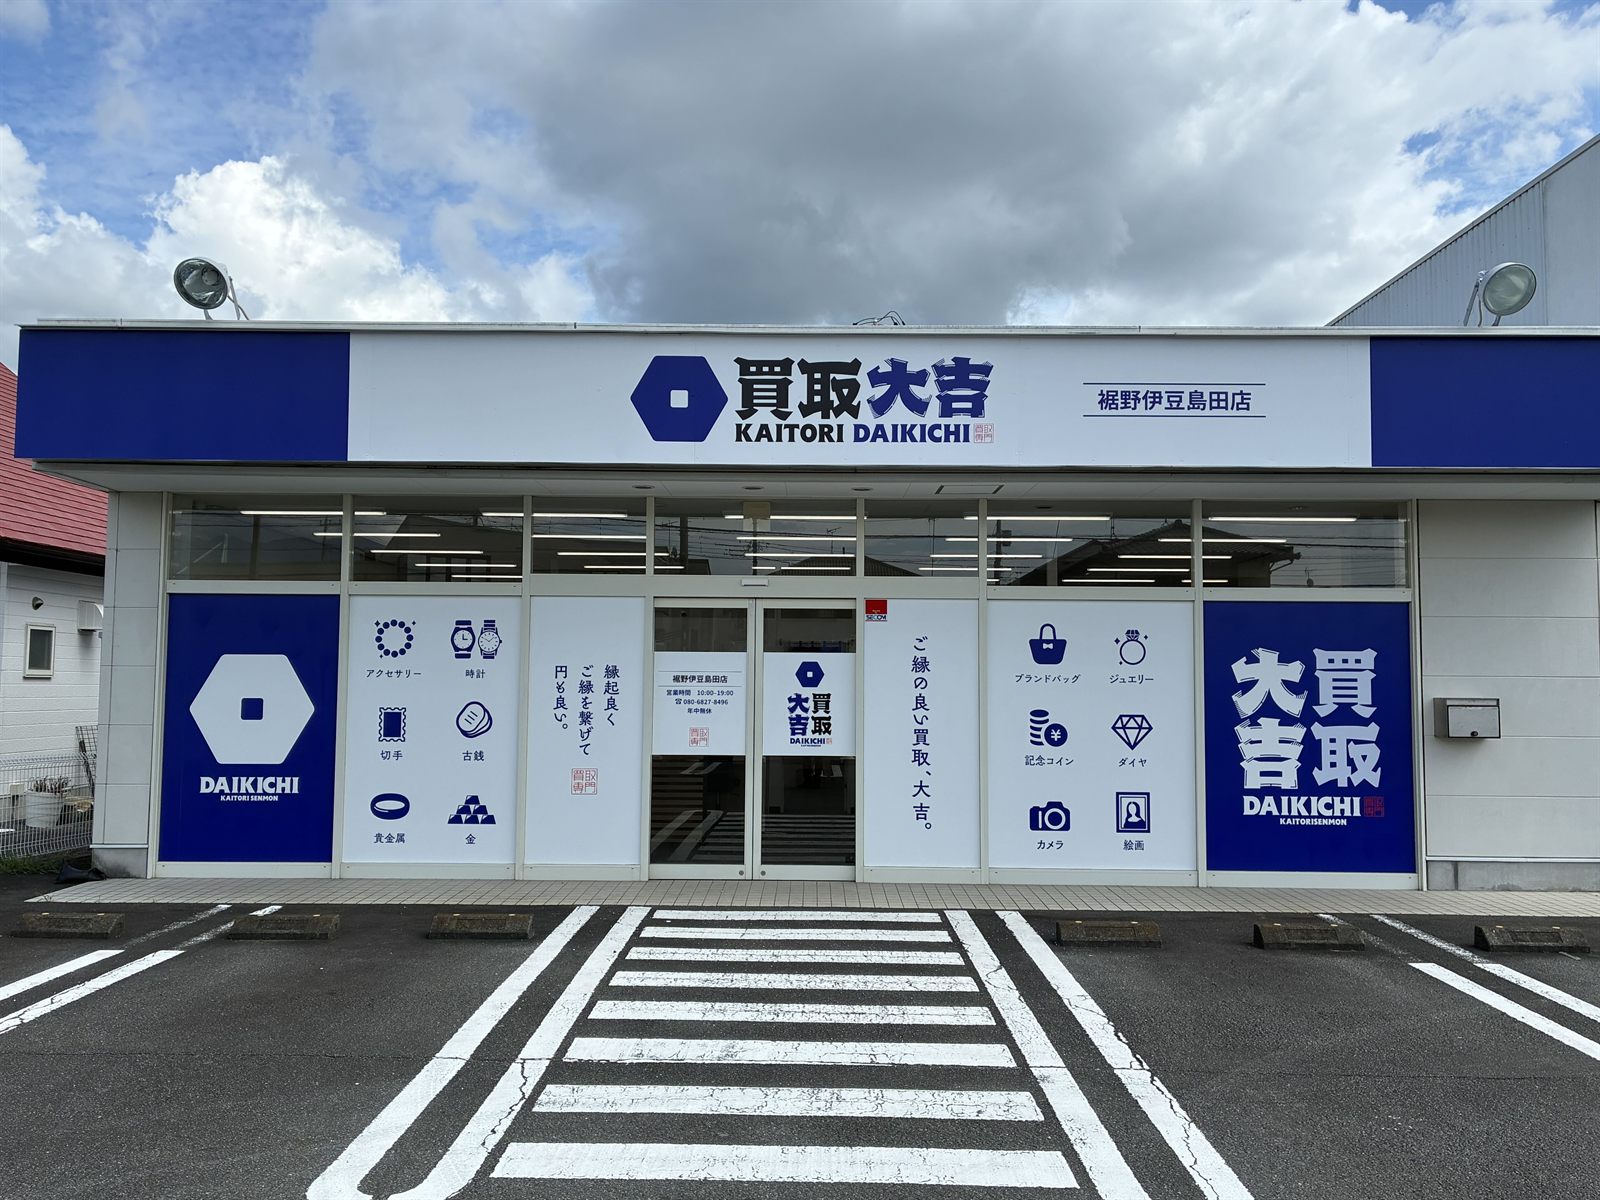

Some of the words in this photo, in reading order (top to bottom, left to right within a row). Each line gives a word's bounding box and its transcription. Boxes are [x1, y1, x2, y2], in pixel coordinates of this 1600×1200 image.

[734, 356, 994, 420] 買取大吉
[1097, 389, 1252, 412] 裾野伊豆島田店
[735, 423, 844, 442] KAITORI
[853, 423, 970, 443] DAIKICHI
[366, 669, 422, 679] アクセサリー
[465, 668, 486, 679] 時計
[672, 674, 728, 684] 裾野伊豆島田店
[1015, 673, 1081, 684] ブランドバッグ
[1109, 674, 1154, 685] ジュエリー
[553, 665, 568, 730] 円も良い。
[603, 664, 620, 727] 縁起良く
[666, 689, 692, 697] 営業時間
[577, 664, 595, 756] ご縁を繋げて
[787, 693, 810, 737] 大吉
[811, 693, 832, 736] 買取
[1231, 647, 1308, 790] 大吉
[1311, 647, 1381, 788] 買取
[911, 635, 932, 830] ご縁の良い買取、大吉。
[380, 749, 404, 761] 切手
[461, 749, 485, 762] 古銭
[1024, 754, 1074, 767] 記念コイン
[1118, 757, 1147, 768] ダイヤ
[199, 776, 300, 794] DAIKICHI
[1243, 795, 1361, 817] DAIKICHI
[373, 832, 406, 844] 貴金属
[465, 833, 477, 845] 金
[1036, 839, 1064, 850] カメラ
[1122, 839, 1145, 851] 絵画
